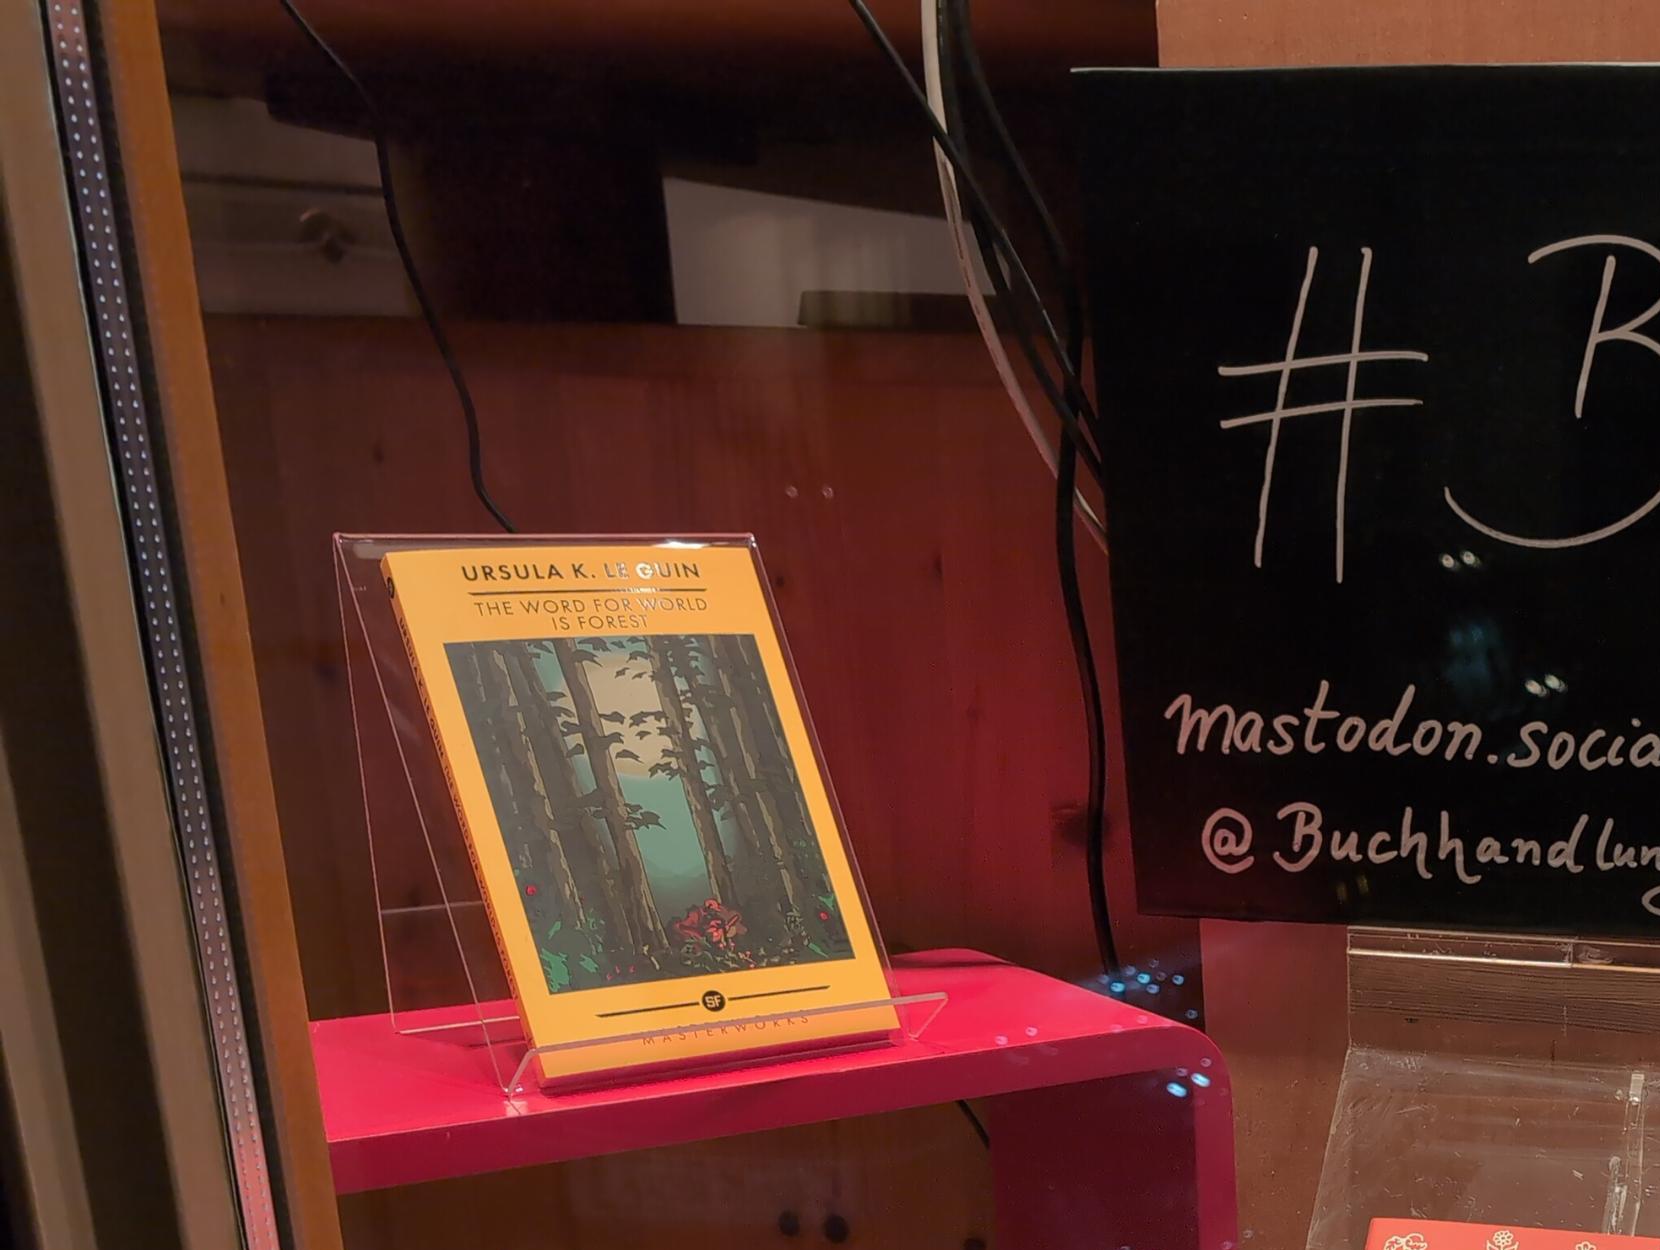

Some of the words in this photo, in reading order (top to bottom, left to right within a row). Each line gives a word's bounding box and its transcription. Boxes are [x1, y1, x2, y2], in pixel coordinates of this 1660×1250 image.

[461, 562, 564, 582] URSULA
[572, 562, 596, 579] K.
[603, 562, 629, 579] LE
[635, 561, 701, 580] GUIN
[474, 600, 513, 617] THE
[520, 599, 586, 616] WORD
[595, 597, 634, 613] FOR
[636, 597, 708, 613] WORLD
[552, 616, 571, 631] IS
[579, 614, 650, 631] FOREST
[704, 994, 722, 1008] SF
